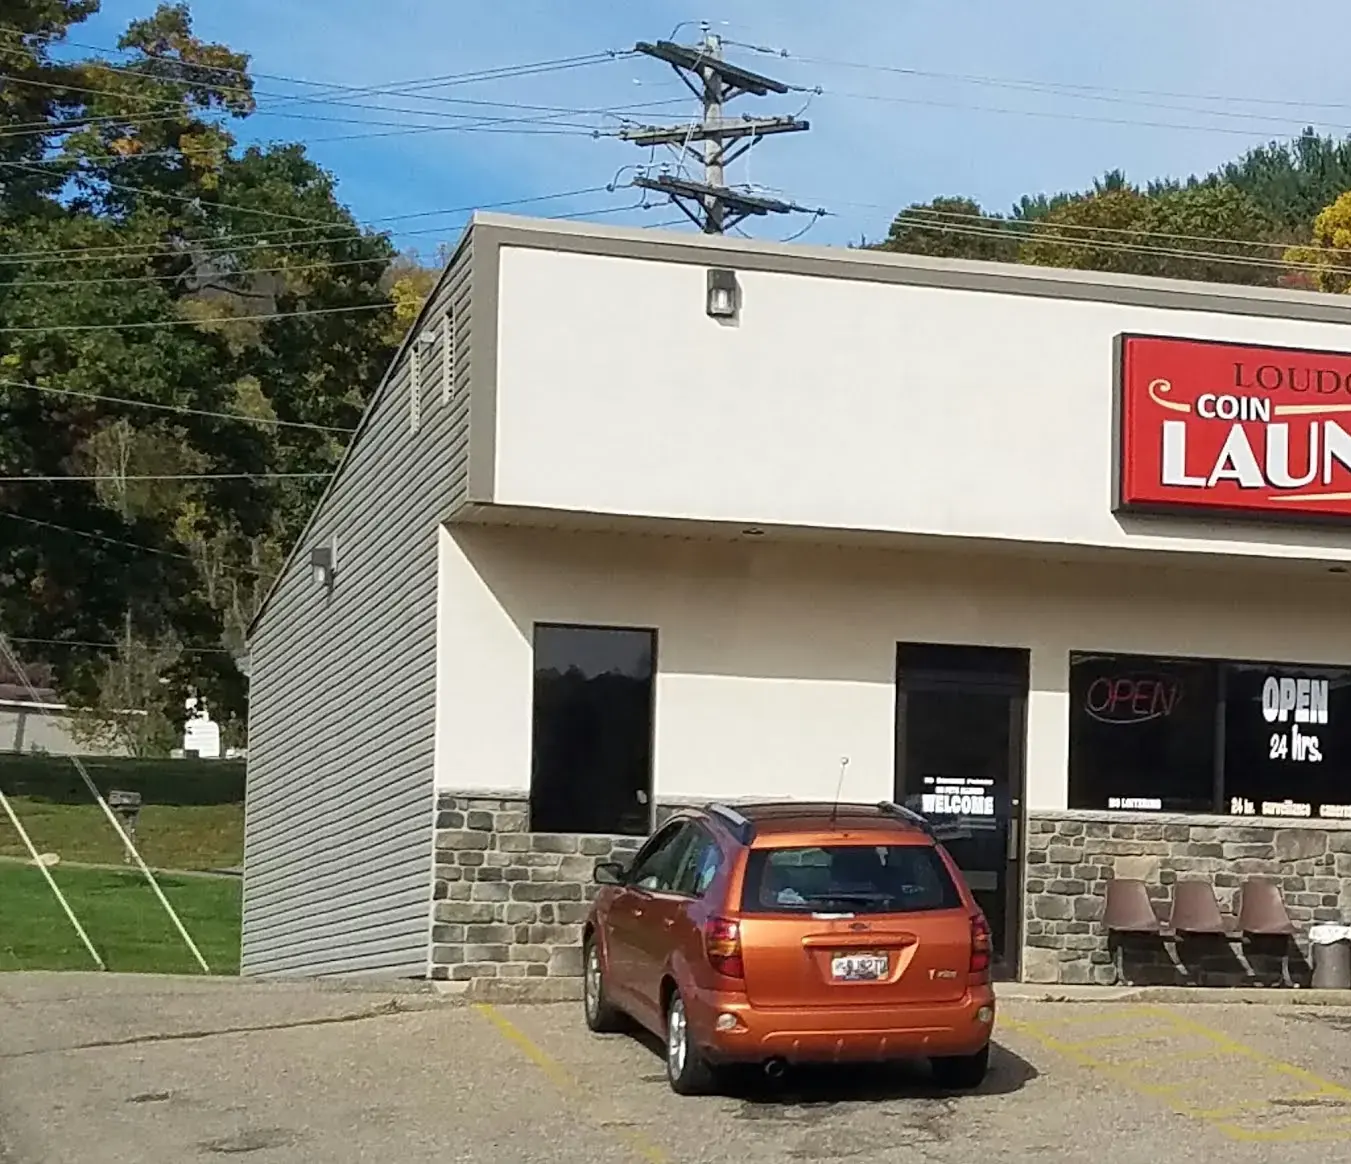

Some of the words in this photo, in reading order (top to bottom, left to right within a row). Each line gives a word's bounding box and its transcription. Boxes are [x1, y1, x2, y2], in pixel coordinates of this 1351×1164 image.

[1197, 393, 1271, 422] COIN
[1087, 678, 1176, 716] OPEN
[1262, 676, 1329, 724] OPEN
[1269, 733, 1288, 759] 24
[1291, 723, 1323, 762] hrs.
[921, 793, 994, 815] WELCOME
[1230, 796, 1243, 815] 24
